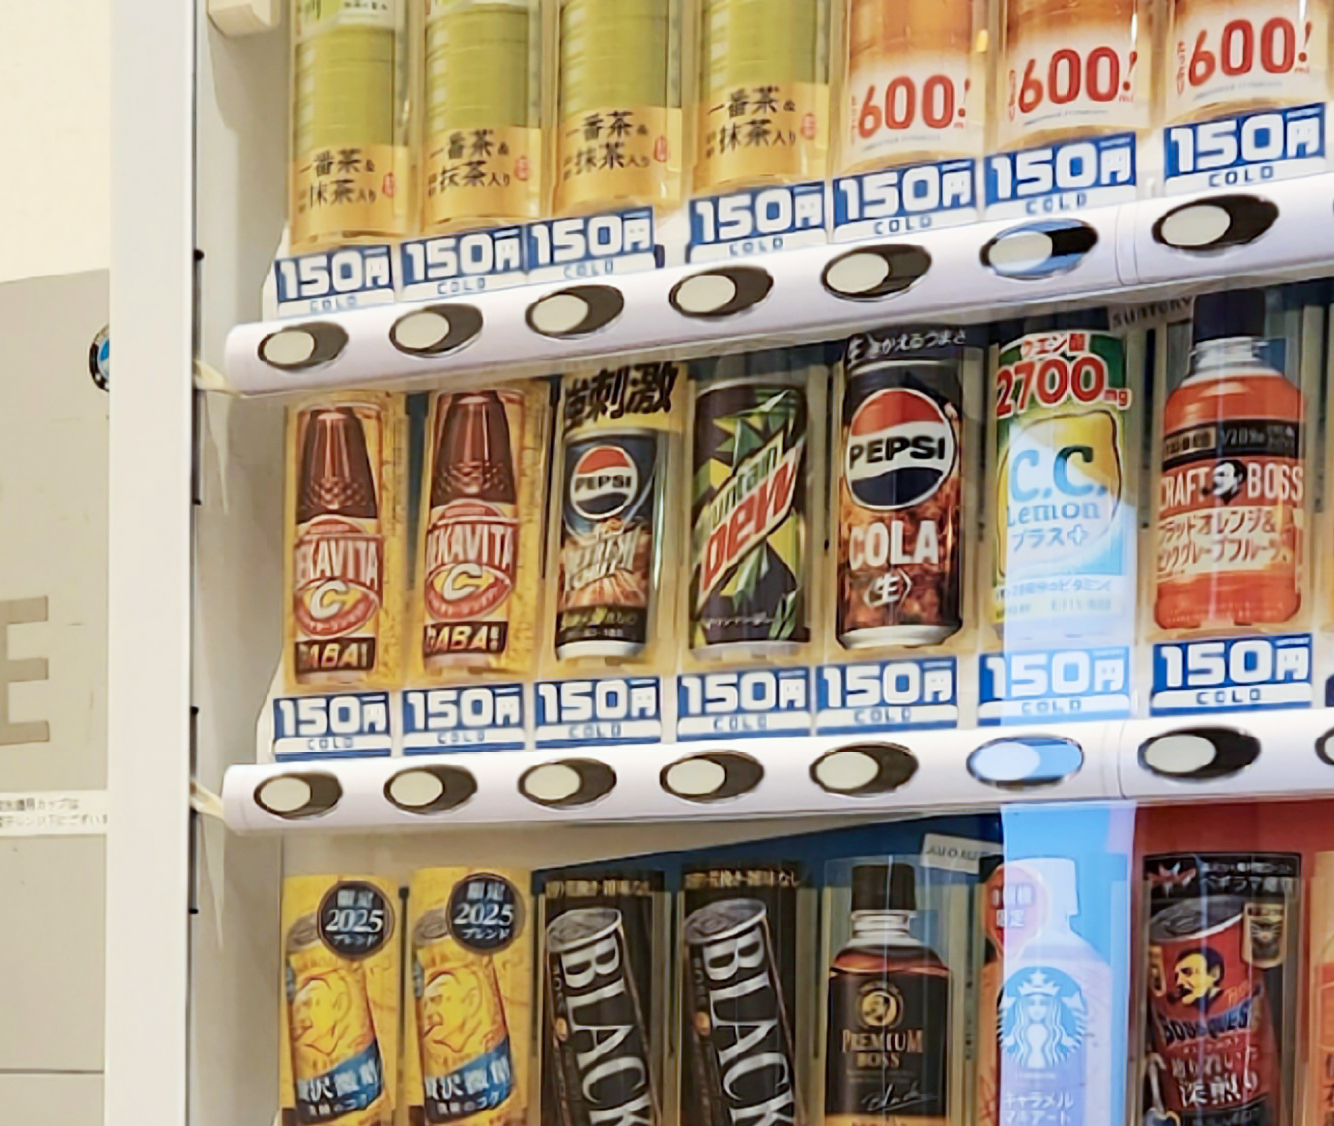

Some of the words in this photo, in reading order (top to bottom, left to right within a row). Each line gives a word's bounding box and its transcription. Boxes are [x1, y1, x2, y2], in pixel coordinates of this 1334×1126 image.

[1169, 113, 1320, 173] 150円
[991, 142, 1131, 199] 150円
[1208, 165, 1274, 188] COLD
[838, 164, 972, 220] 150円
[1026, 193, 1087, 215] COLD
[695, 188, 823, 242] 150円
[873, 215, 933, 236] COLD
[404, 233, 520, 281] 150円
[532, 214, 652, 266] 150円
[280, 249, 390, 299] 150円
[848, 436, 946, 470] PEPSI
[1010, 445, 1107, 501] C.C.
[574, 474, 632, 494] PEPSI
[1246, 462, 1304, 501] BOSS
[1006, 502, 1101, 528] Lemon
[848, 519, 940, 571] COLA
[309, 579, 349, 620] C
[442, 562, 483, 601] C
[986, 651, 1125, 698] 150円
[1161, 639, 1309, 688] 150円
[538, 680, 657, 723] 150円
[680, 671, 807, 715] 150円
[823, 662, 953, 708] 150円
[1196, 688, 1261, 705] COLD
[279, 696, 386, 737] 150円
[407, 688, 520, 731] 150円
[853, 707, 912, 723] COLD
[1021, 699, 1081, 715] COLD
[324, 908, 385, 934] 2025
[453, 902, 515, 926] 2025
[842, 1028, 924, 1054] PREMIUM
